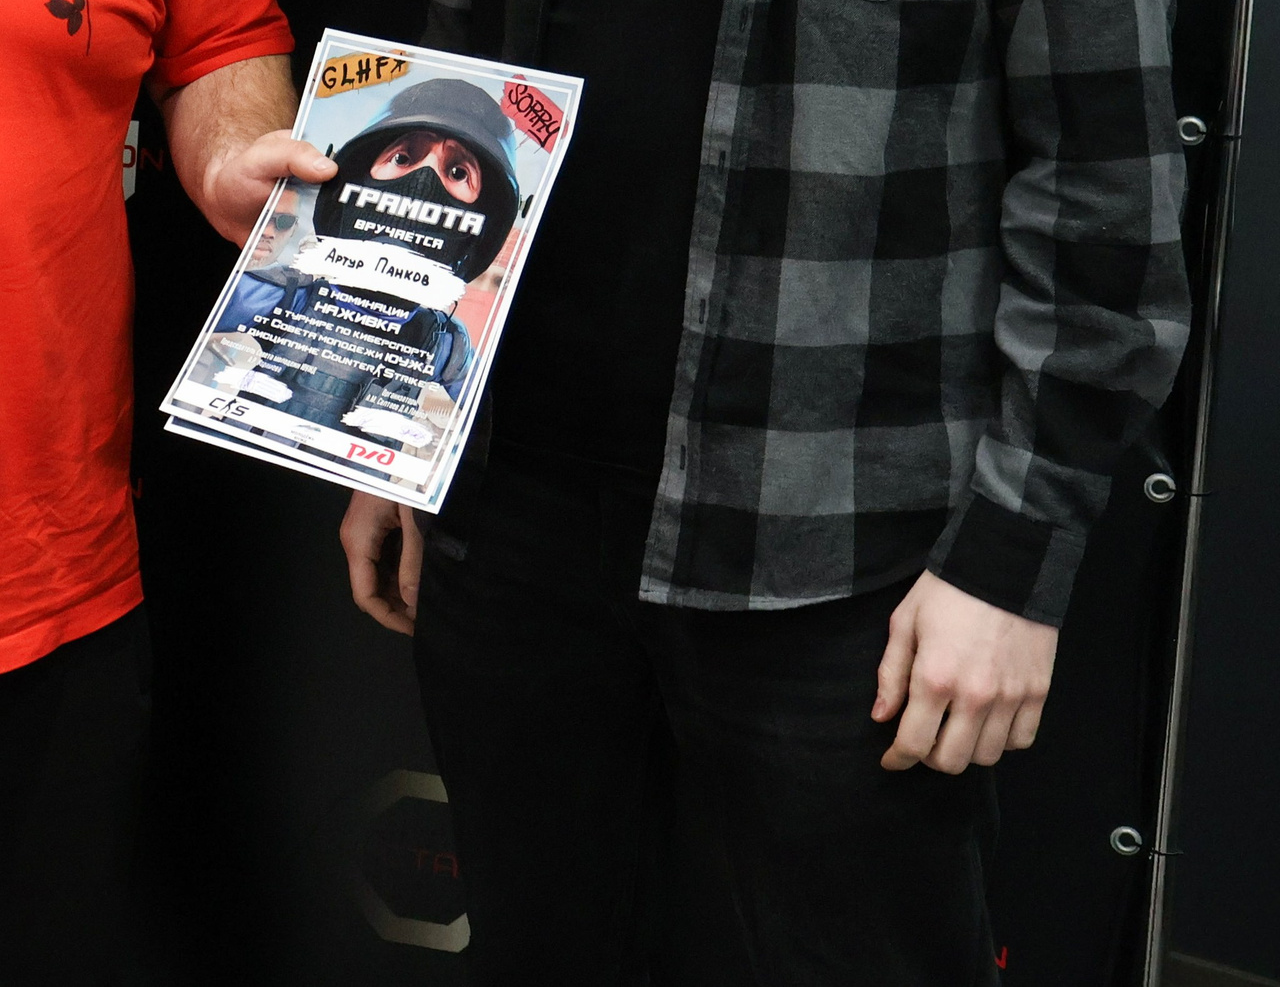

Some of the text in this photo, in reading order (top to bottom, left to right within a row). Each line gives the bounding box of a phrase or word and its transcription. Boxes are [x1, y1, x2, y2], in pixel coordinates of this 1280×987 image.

[508, 83, 560, 147] SORRY
[338, 182, 486, 236] ГРАМОТА
[314, 301, 404, 335] НАЖИВКА
